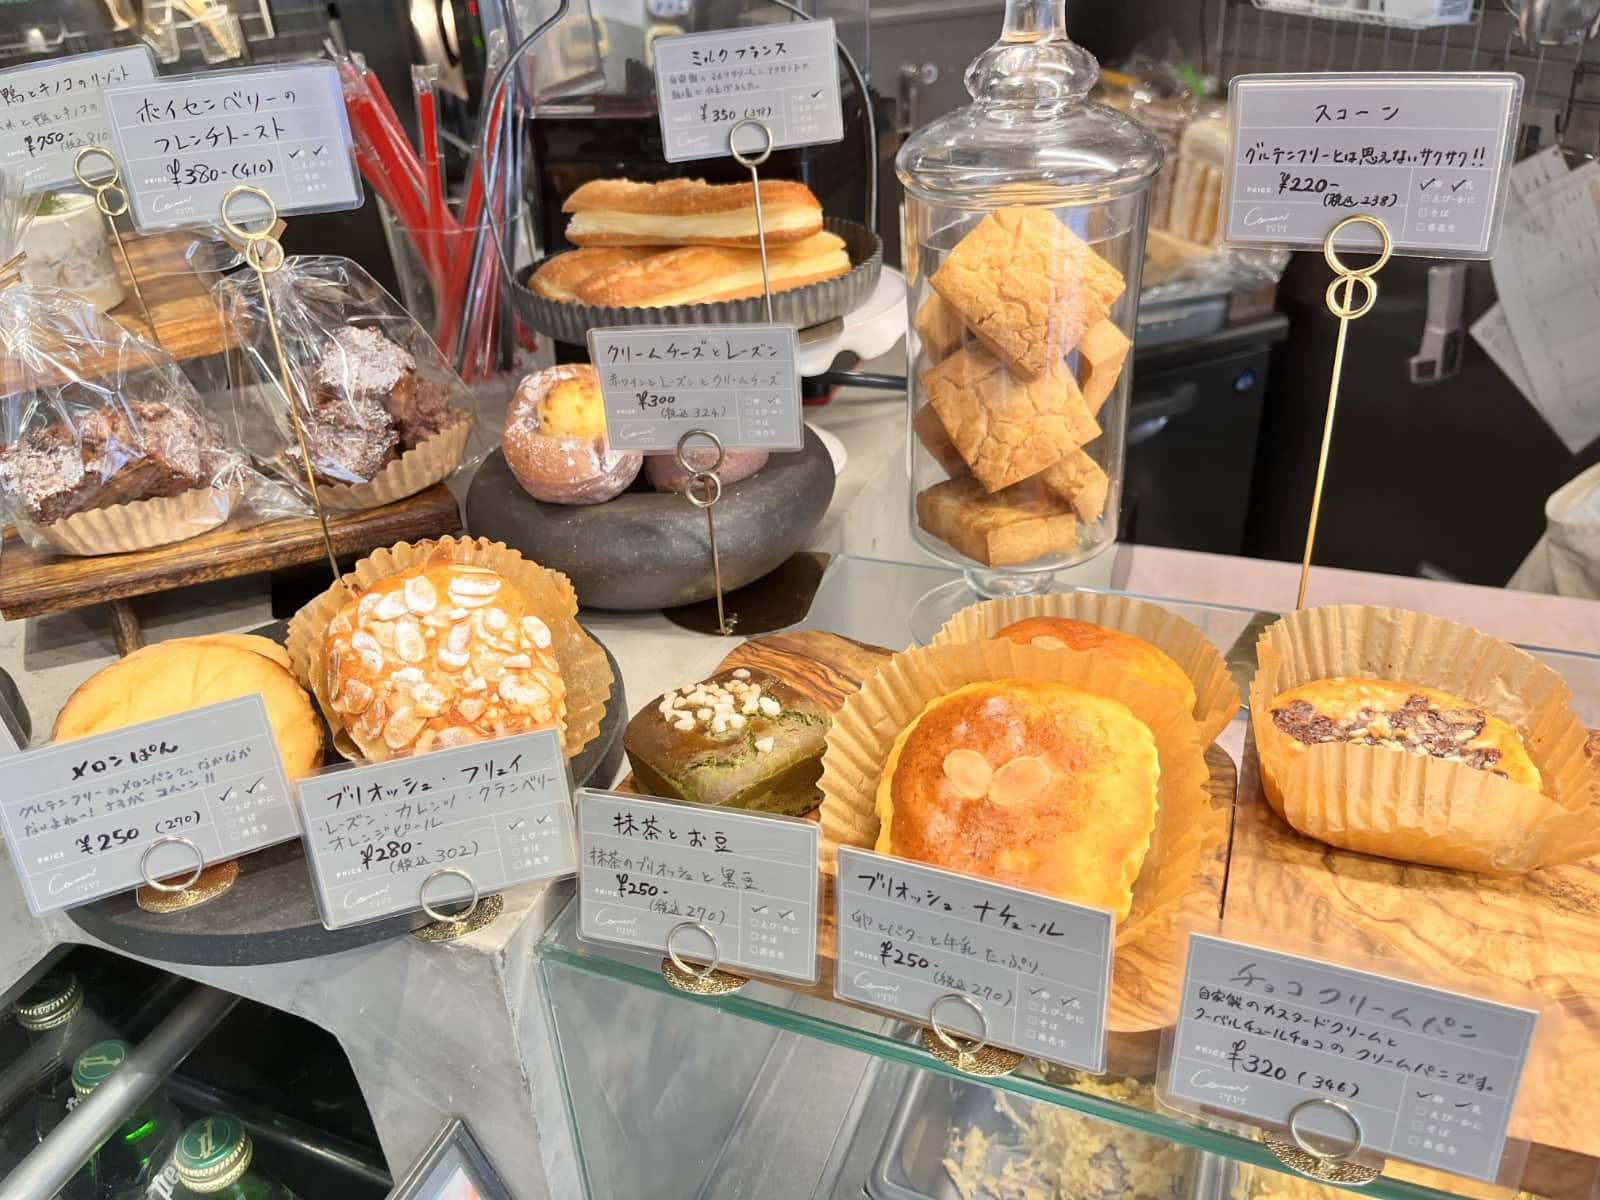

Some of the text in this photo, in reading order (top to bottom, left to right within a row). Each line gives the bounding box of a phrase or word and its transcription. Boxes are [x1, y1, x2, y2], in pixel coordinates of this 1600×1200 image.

[1315, 103, 1400, 123] スコーン
[636, 390, 676, 411] ¥300
[71, 741, 179, 781] メロンぱん
[75, 810, 202, 855] ¥250 (270)
[613, 811, 734, 853] 抹茶とお豆
[1226, 1039, 1288, 1081] ¥320
